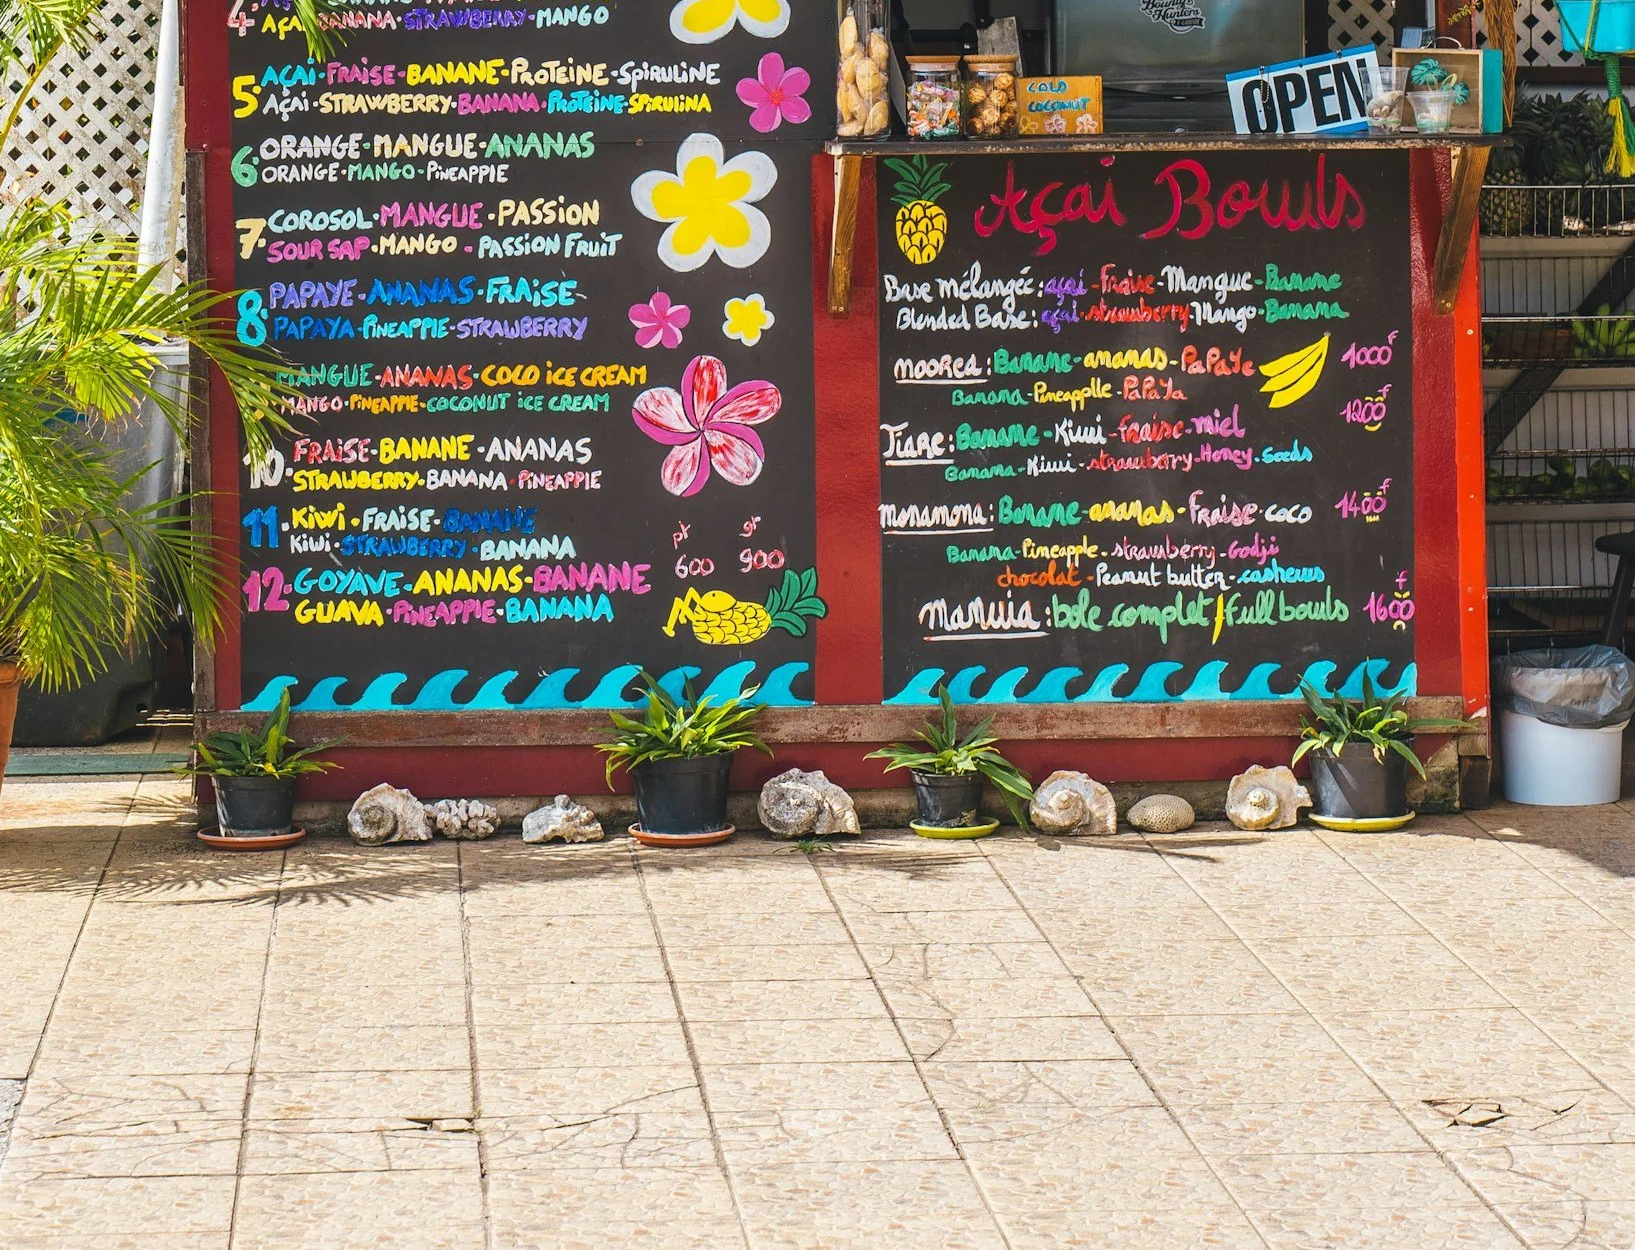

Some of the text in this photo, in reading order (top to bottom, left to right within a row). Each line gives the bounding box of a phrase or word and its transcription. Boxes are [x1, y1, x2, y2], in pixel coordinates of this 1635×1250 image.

[404, 8, 526, 31] STRAWBERRY
[536, 6, 609, 28] MANGO
[1153, 8, 1199, 23] Hunters
[406, 58, 505, 86] BANANE
[1027, 80, 1068, 93] COLD
[318, 92, 452, 115] STRAWBERRY
[458, 91, 540, 114] BANANA
[1027, 97, 1091, 112] COCONUT
[1242, 58, 1370, 134] OPEN
[259, 133, 363, 160] ORANGE
[374, 132, 478, 159] MANGUE
[484, 131, 595, 160] ANANAS
[262, 162, 415, 184] ORANGE MANGO
[267, 206, 373, 234] COROSOL
[380, 201, 483, 230] MANGUE
[266, 238, 323, 264] SOUR
[328, 235, 370, 261] SAP
[379, 232, 457, 256] MANGO
[269, 278, 357, 310] PAPAYE
[366, 275, 477, 307] ANANAS
[884, 274, 933, 303] Base
[1161, 265, 1253, 304] Mangue
[1265, 263, 1343, 292] Banane
[274, 315, 588, 341] PAPAYA STRAWBERRY
[897, 303, 971, 331] Blended
[1191, 302, 1256, 333] Mango
[1264, 297, 1349, 323] Banana
[994, 347, 1168, 374] Banane ananas
[379, 364, 473, 390] ANANAS
[480, 363, 541, 387] COCO
[580, 364, 647, 387] CREAM
[427, 392, 511, 413] COCONUT
[548, 392, 610, 413] CREAM
[952, 388, 1029, 406] Banana
[379, 434, 475, 465] BANANE
[485, 436, 592, 465] ANANAS
[955, 422, 1041, 451] Banane
[944, 462, 1018, 482] Banana
[1200, 443, 1253, 470] Honey
[293, 468, 508, 492] STRAWBERRY BANANA
[443, 505, 538, 534] BANANE
[998, 494, 1082, 528] Banane
[1089, 499, 1175, 527] ananas
[340, 534, 467, 559] STRAWBERRY
[480, 534, 577, 561] BANANA
[738, 547, 785, 573] 900
[946, 544, 1018, 564] Banana
[1022, 535, 1099, 569] Pineapple
[294, 567, 404, 597] GOYAVE
[412, 564, 524, 596] ANANAS
[533, 562, 651, 595] BANANE
[674, 554, 715, 579] 600
[997, 559, 1083, 588] chocolat
[1095, 562, 1161, 587] Peanut
[294, 593, 614, 627] GUAVA BANANA
[1052, 587, 1103, 632] bole
[1108, 590, 1214, 646] complet
